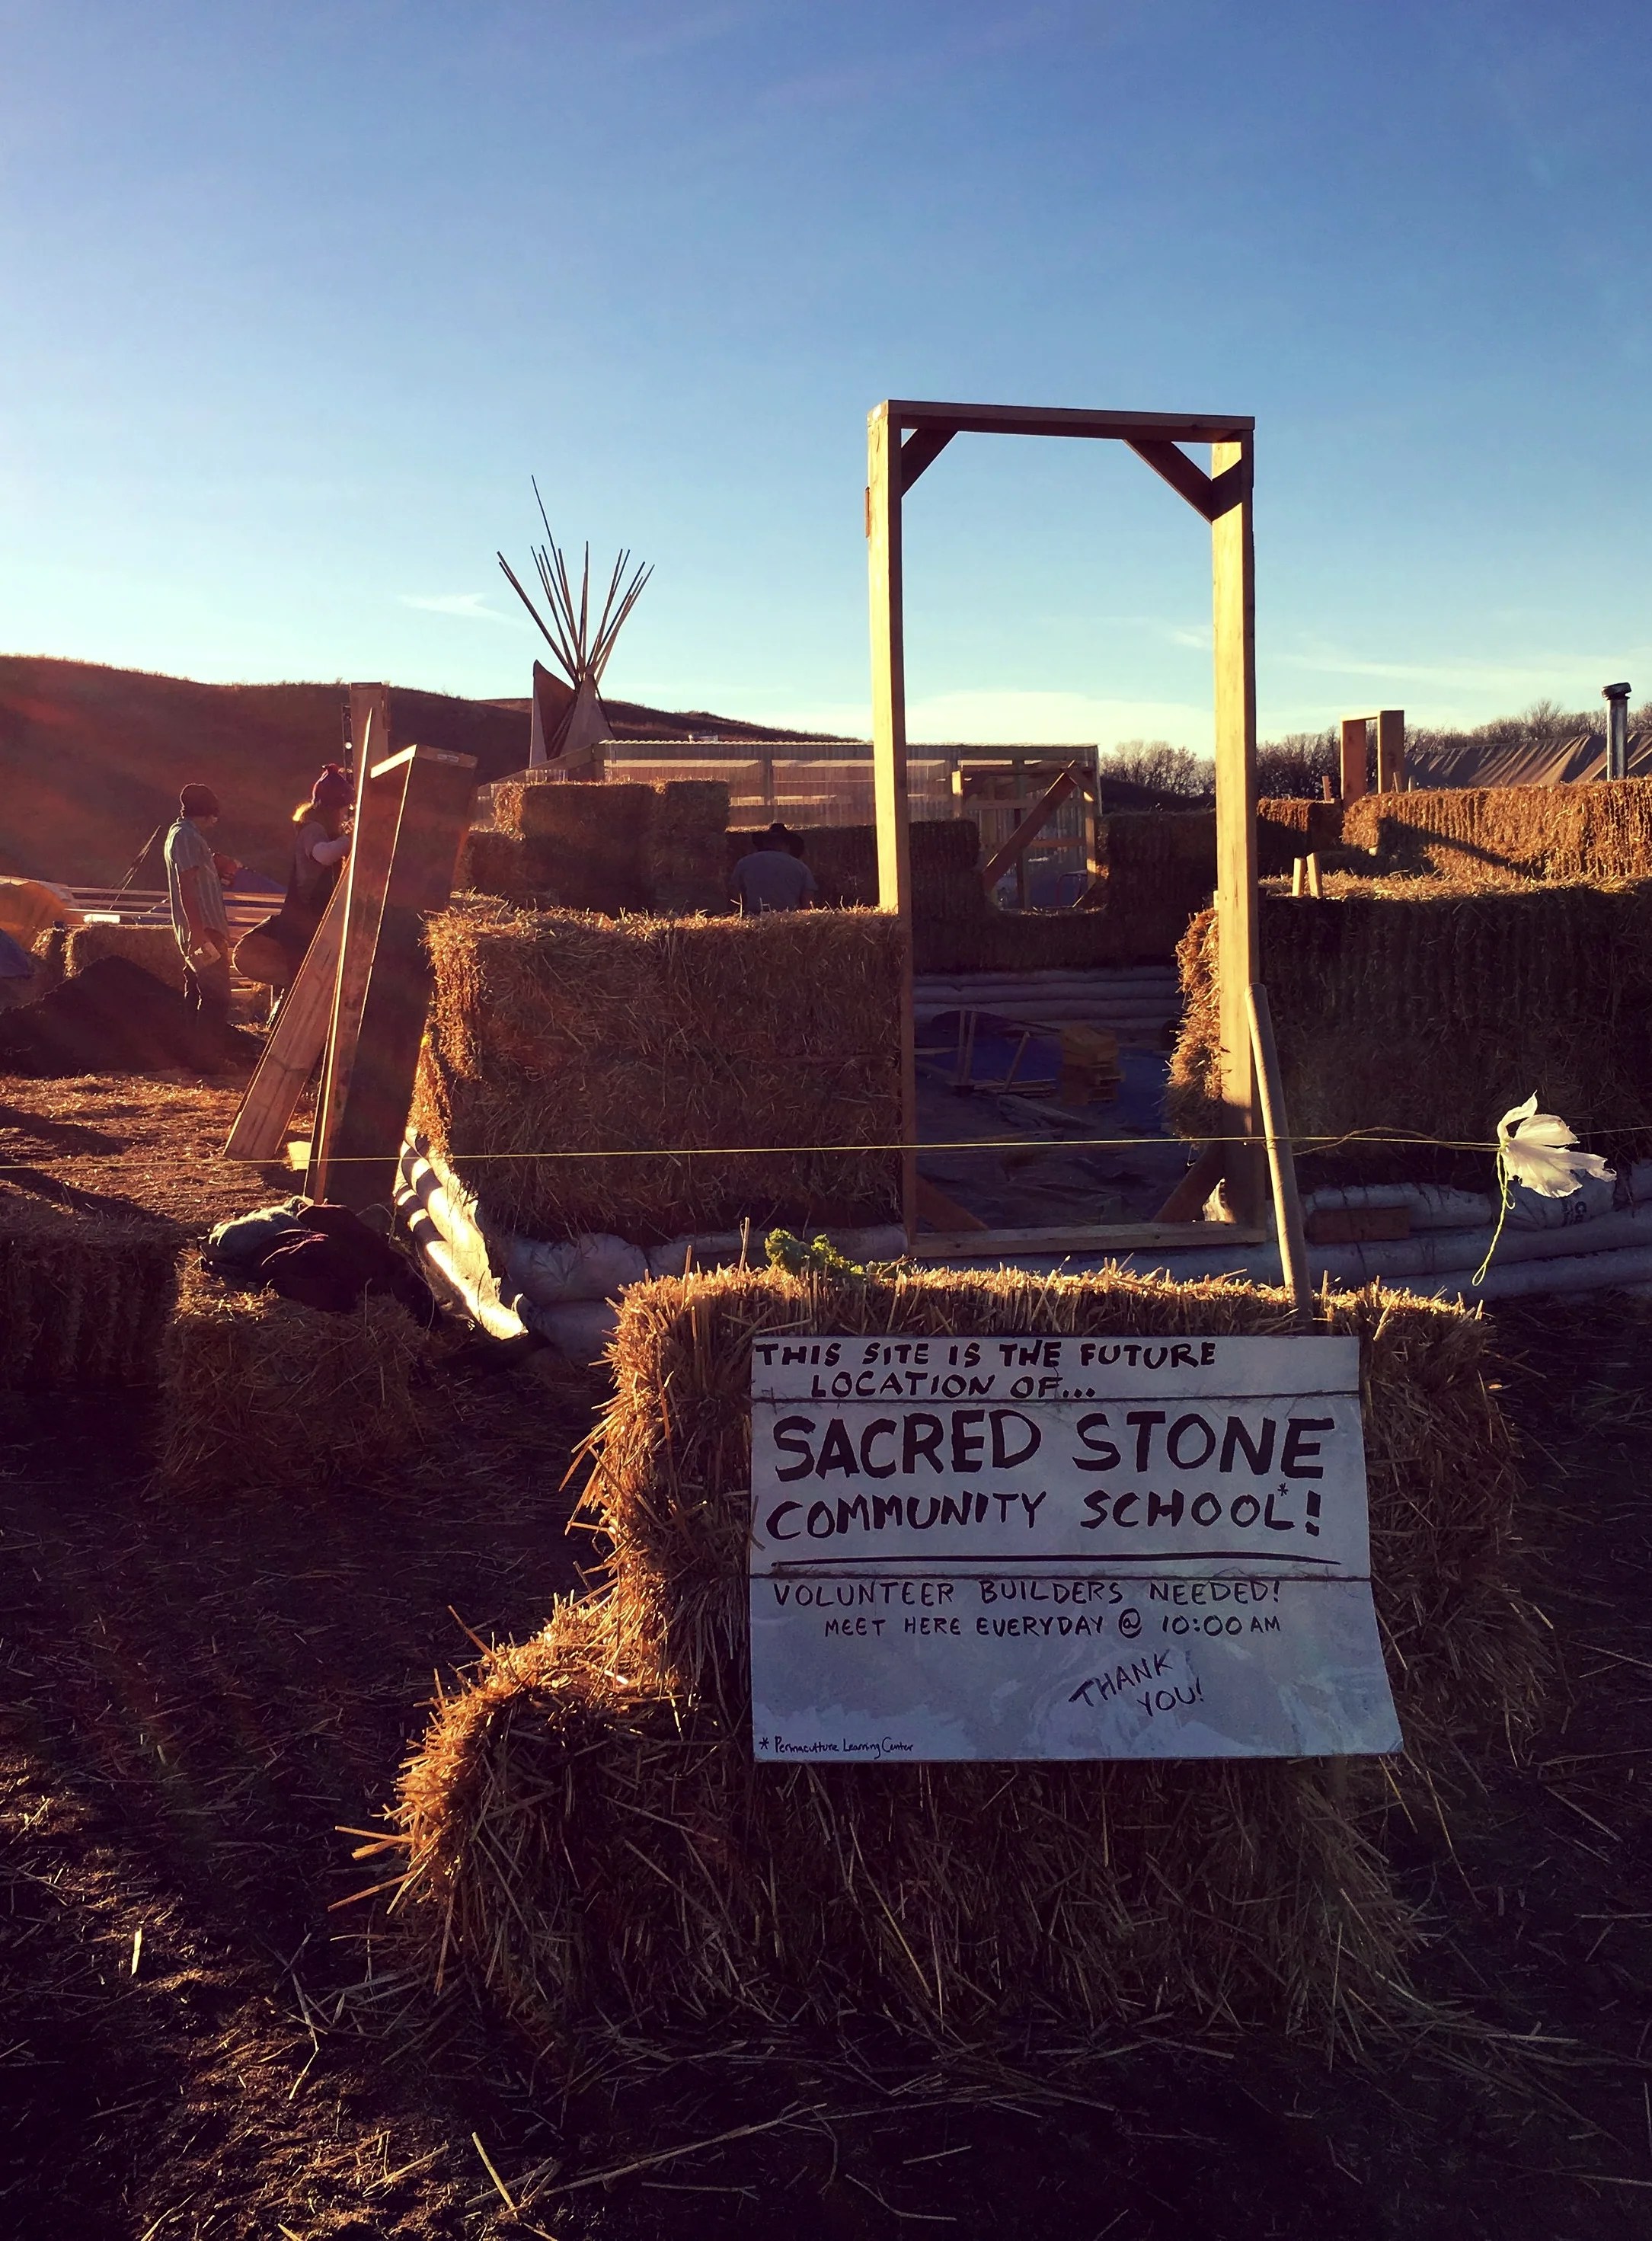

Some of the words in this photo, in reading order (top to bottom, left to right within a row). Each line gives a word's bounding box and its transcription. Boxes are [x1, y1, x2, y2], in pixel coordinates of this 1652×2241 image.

[756, 1343, 841, 1367] THIS
[862, 1342, 928, 1365] SITE
[948, 1343, 981, 1367] IS
[999, 1339, 1062, 1367] THE
[1081, 1341, 1216, 1369] FUTURE
[811, 1370, 995, 1398] LOCATION
[773, 1409, 1042, 1482] SACRED
[1072, 1411, 1335, 1479] STONE
[765, 1491, 1046, 1540] COMMUNITY
[774, 1581, 954, 1606] VOLUNTEER
[979, 1580, 1123, 1604] BUILDERS
[1149, 1580, 1280, 1606] NEEDED!
[826, 1617, 886, 1637] MEET
[904, 1616, 961, 1635] HERE
[976, 1616, 1103, 1637] EVERYDAY
[1118, 1607, 1142, 1638] @
[1162, 1615, 1242, 1636] 10:00
[1250, 1616, 1280, 1634] AM
[1069, 1649, 1173, 1707] THANK
[1137, 1677, 1204, 1717] YOU!
[843, 1738, 880, 1760] Learning
